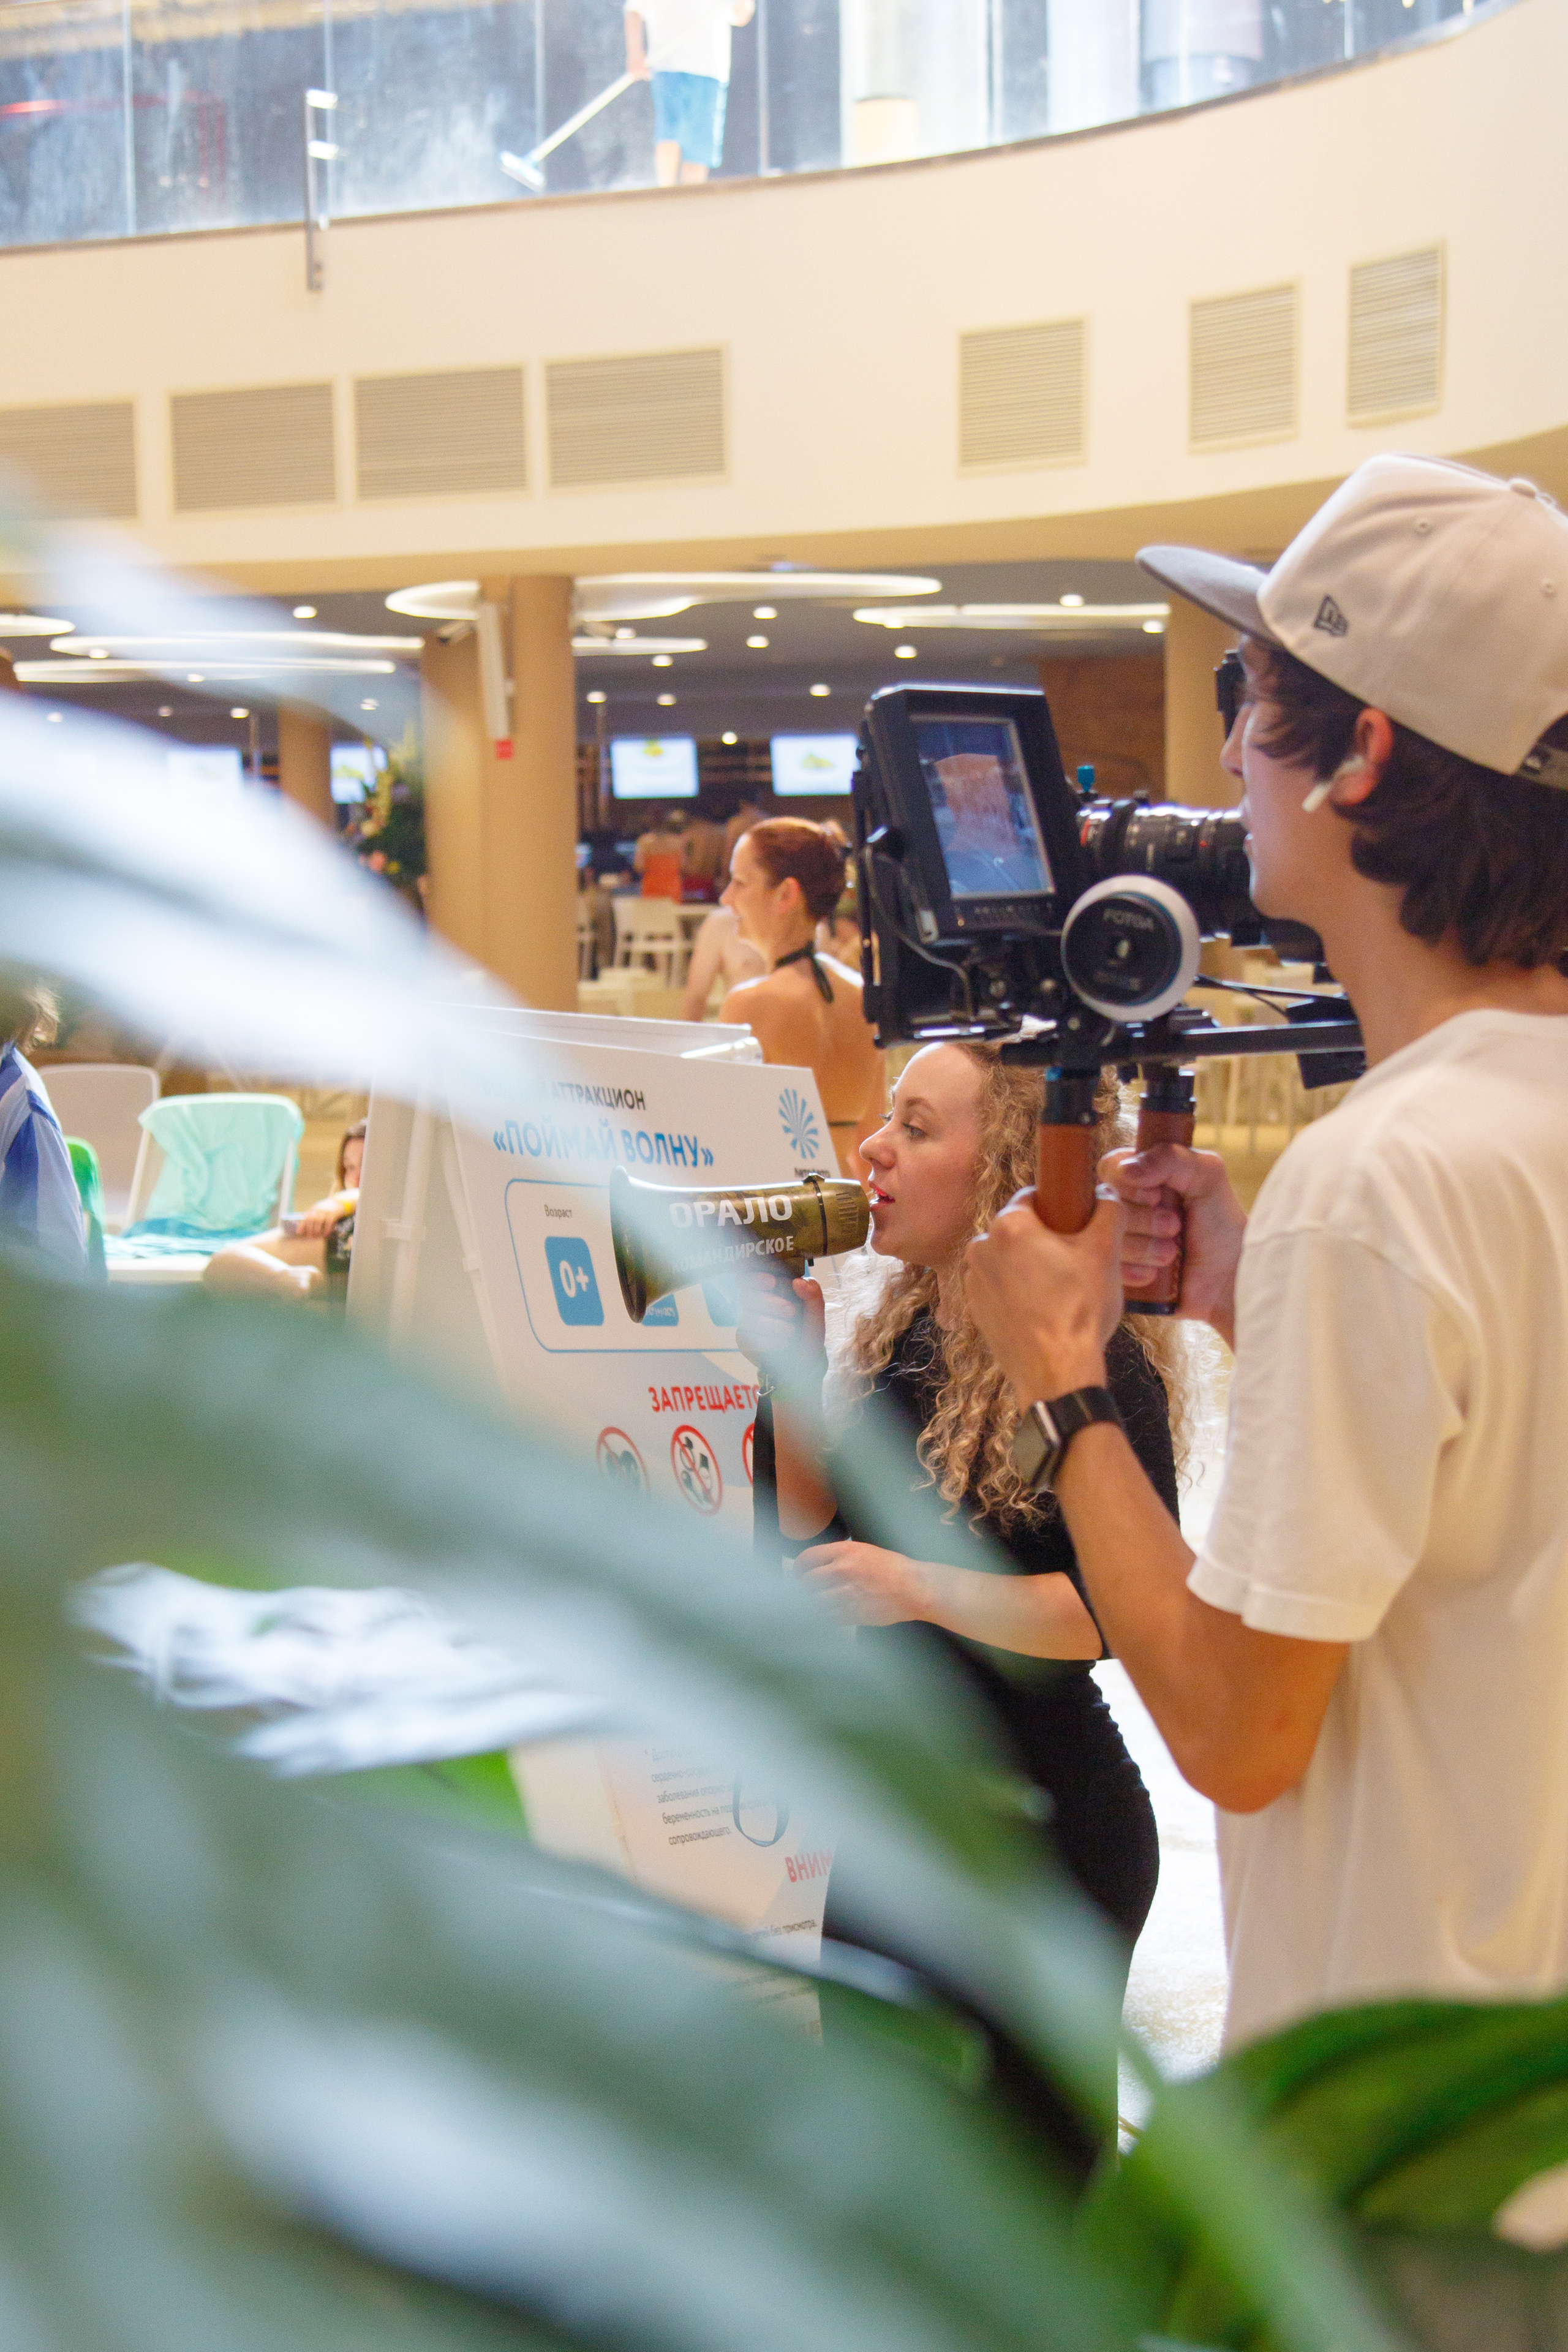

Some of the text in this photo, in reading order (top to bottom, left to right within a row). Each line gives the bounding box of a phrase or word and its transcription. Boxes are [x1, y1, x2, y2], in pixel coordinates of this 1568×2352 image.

[620, 1129, 714, 1168] ВОЛНУ»
[544, 1204, 573, 1219] Возраст
[669, 1194, 793, 1229] ОРАЛО
[559, 1260, 589, 1298] 0+
